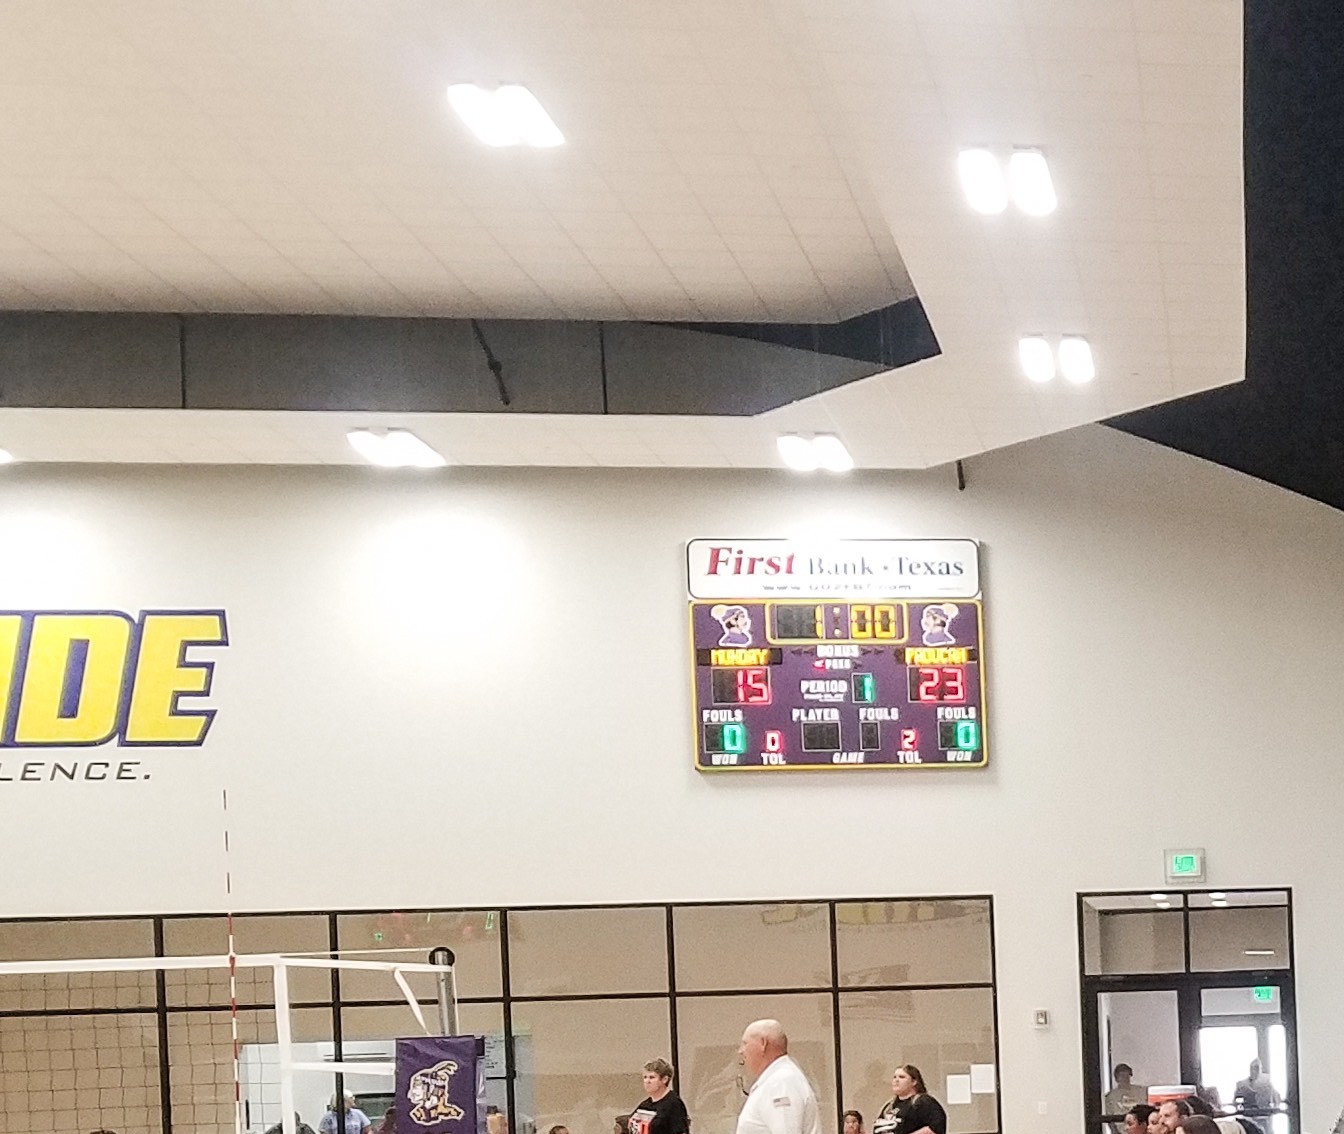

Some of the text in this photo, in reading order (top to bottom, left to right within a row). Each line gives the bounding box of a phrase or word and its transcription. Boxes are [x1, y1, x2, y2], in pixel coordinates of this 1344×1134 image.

[704, 547, 964, 576] First Bank Texas
[737, 670, 769, 702] 15
[800, 680, 848, 693] PERIOD
[918, 668, 963, 700] 23
[702, 709, 743, 722] FOULS
[792, 708, 840, 721] PLAYER
[859, 707, 899, 720] FOULS
[937, 707, 976, 719] FOULS
[722, 723, 744, 752] 0
[902, 730, 917, 750] 2
[956, 722, 977, 749] 0
[761, 752, 786, 765] TOL
[832, 752, 865, 764] GAME
[897, 750, 922, 764] TOL
